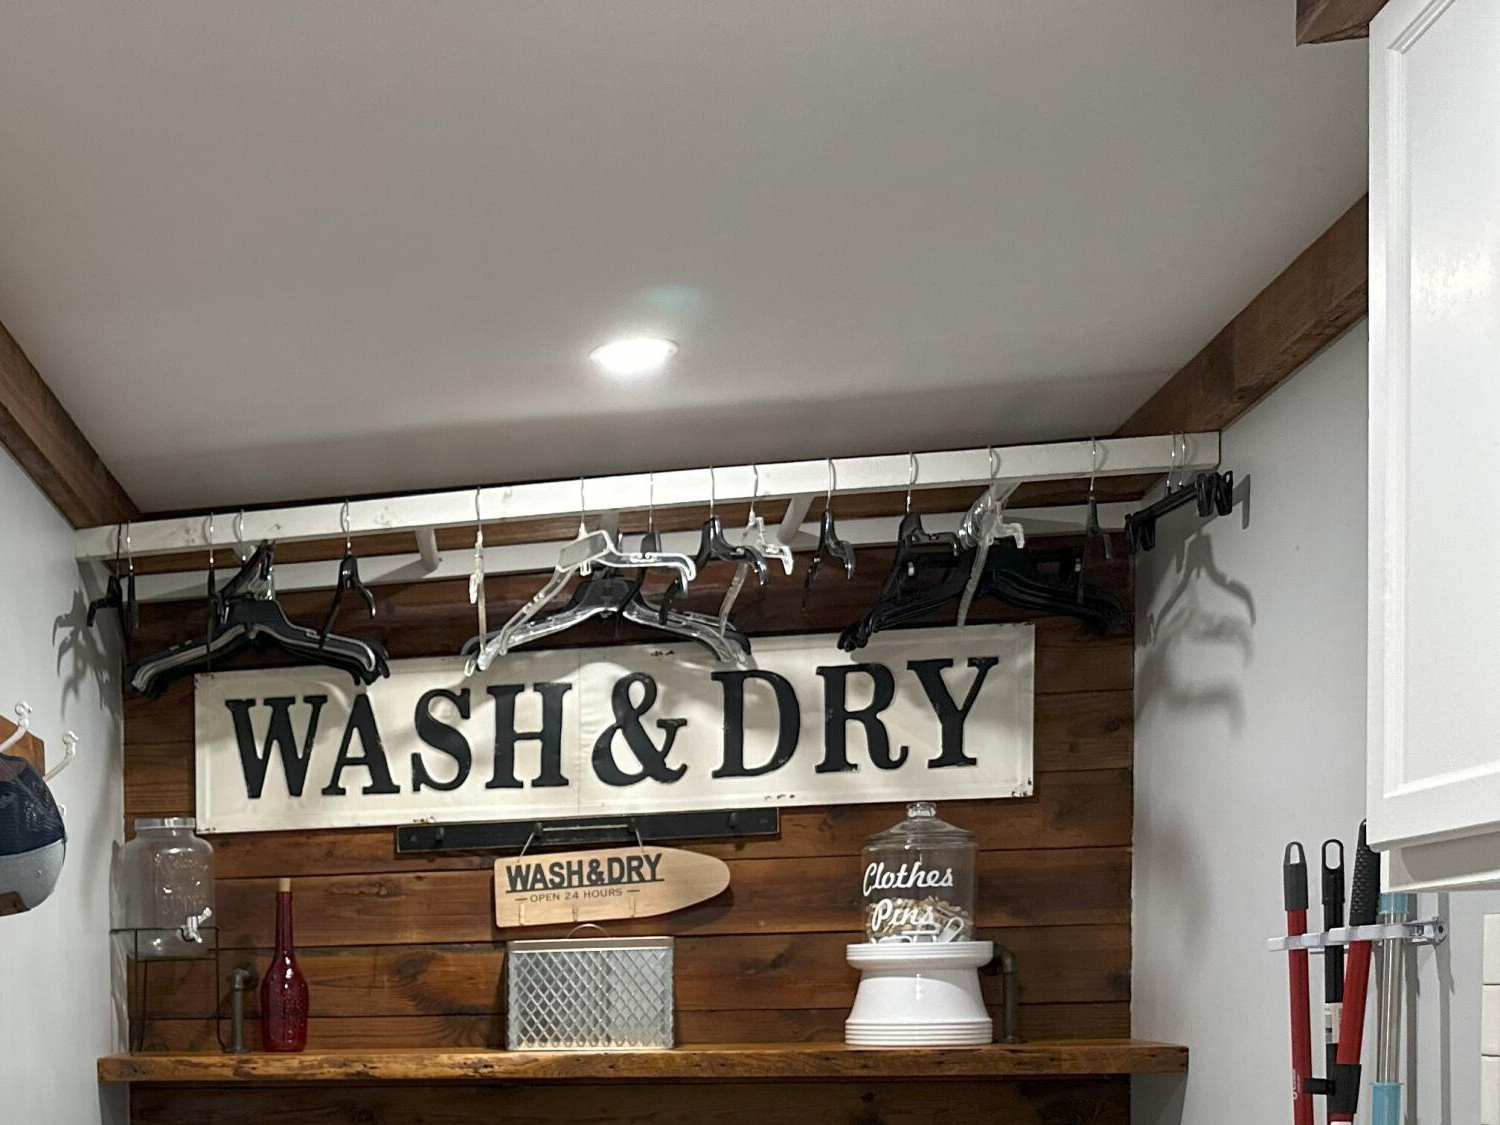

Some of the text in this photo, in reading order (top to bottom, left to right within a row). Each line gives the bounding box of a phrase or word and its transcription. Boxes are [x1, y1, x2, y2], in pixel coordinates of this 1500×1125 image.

[506, 853, 663, 891] WASH&DRY
[863, 861, 954, 897] Clothes
[530, 888, 623, 903] OPEN 24 HOURS
[872, 898, 936, 931] Pins
